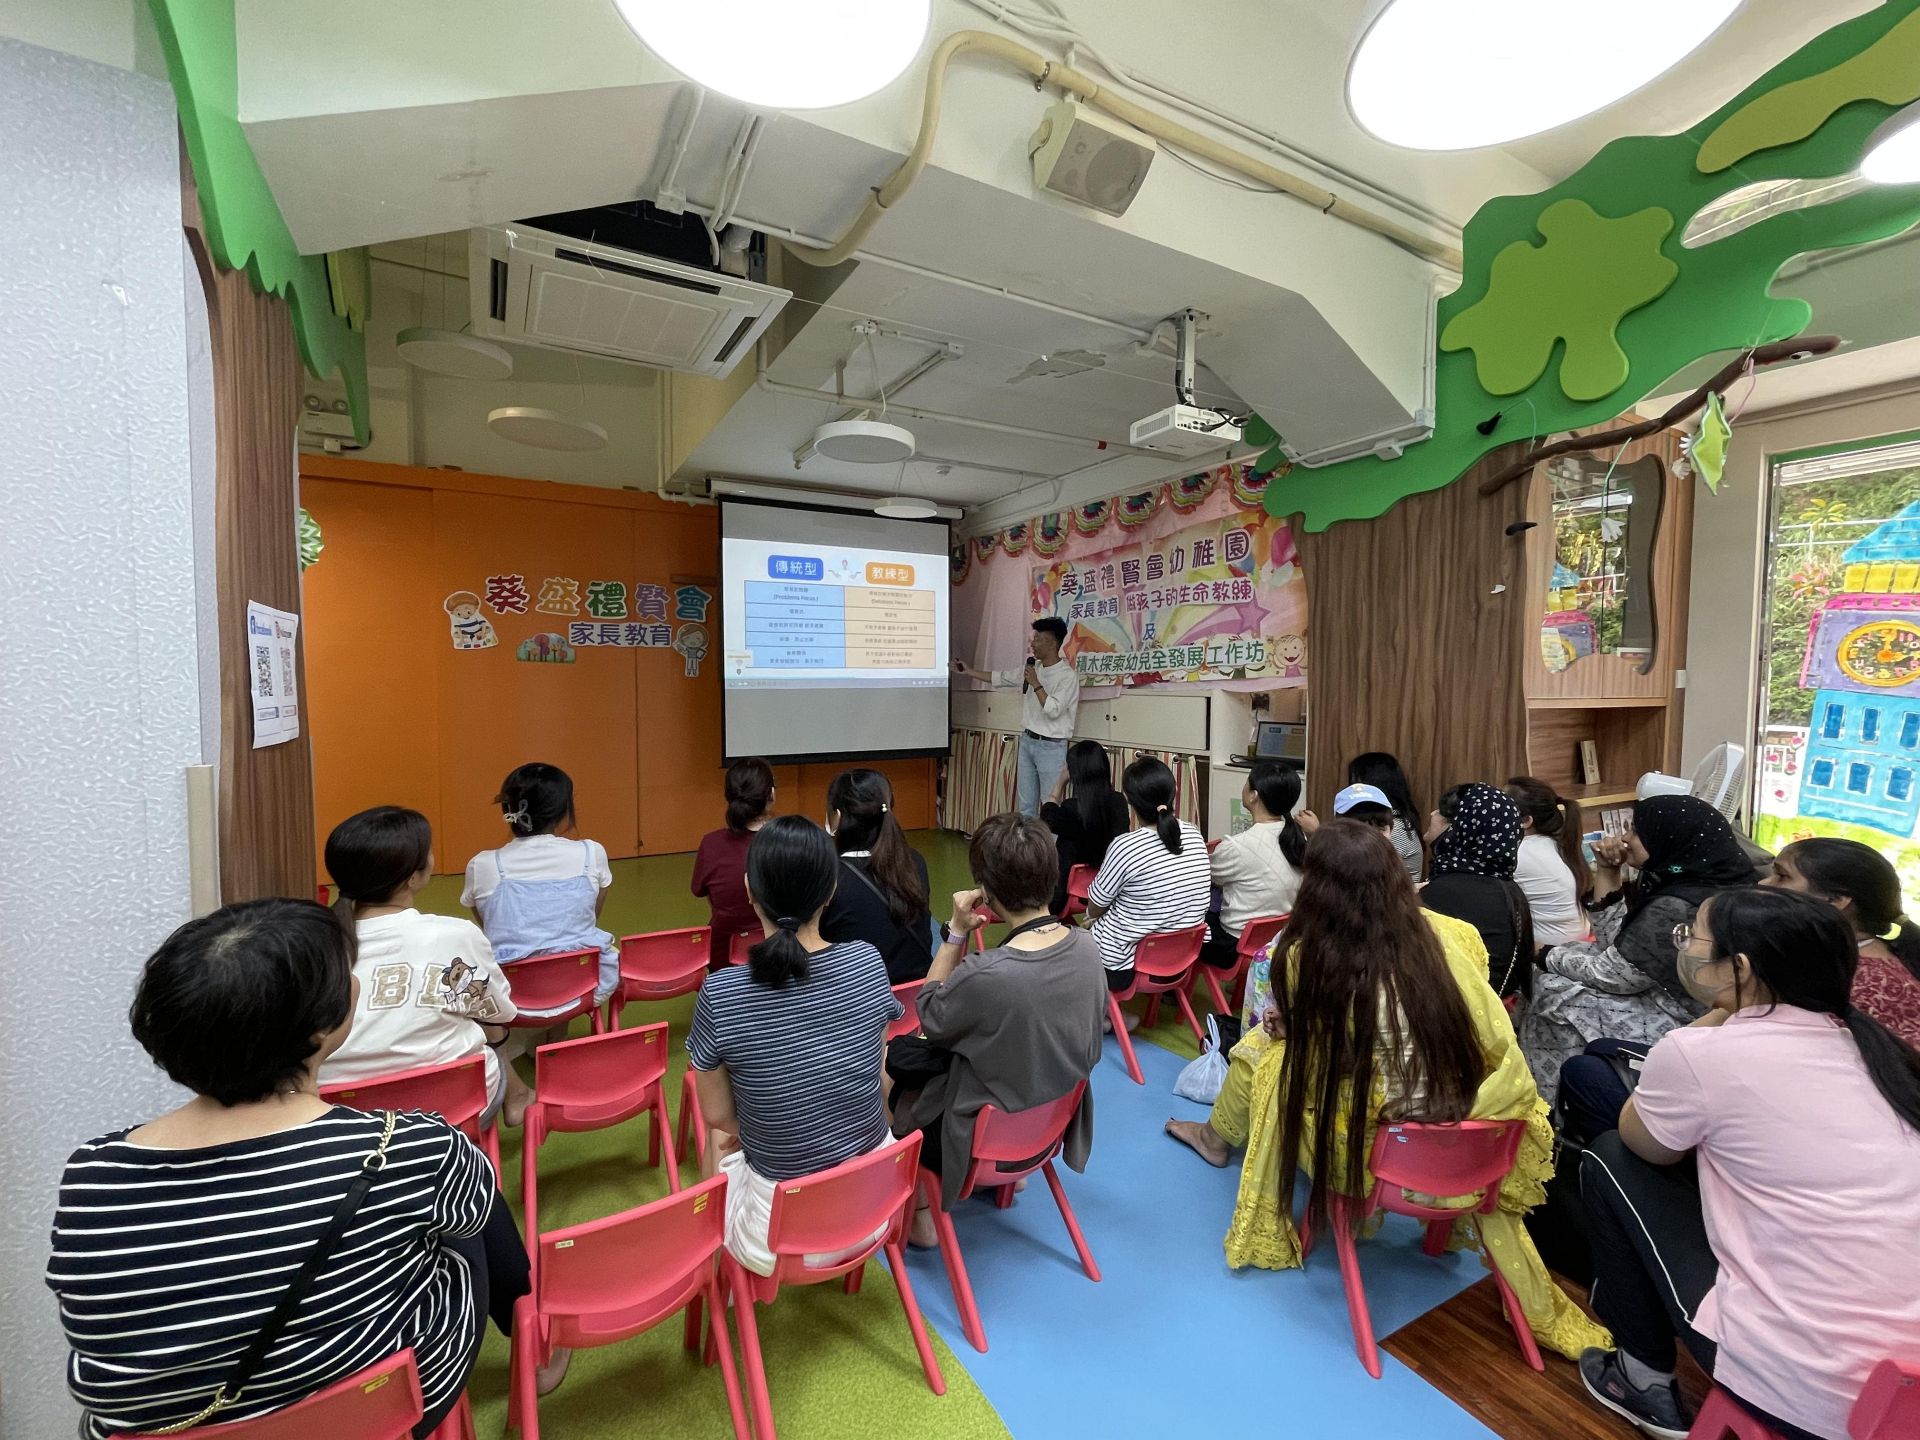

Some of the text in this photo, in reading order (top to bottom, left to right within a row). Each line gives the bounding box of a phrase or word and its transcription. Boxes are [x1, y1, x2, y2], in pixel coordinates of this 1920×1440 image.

[775, 560, 817, 576] 傳統型
[871, 566, 910, 581] 教練型
[1060, 531, 1249, 596] 葵盛禮賢會幼稚園
[485, 574, 713, 622] 葵盛禮賢會
[1070, 579, 1252, 619] 家長教育 做孩子的生命教練
[570, 624, 673, 647] 家長教育
[1142, 623, 1156, 641] 及
[1076, 640, 1265, 673] 積木探索幼兒全發展工作坊
